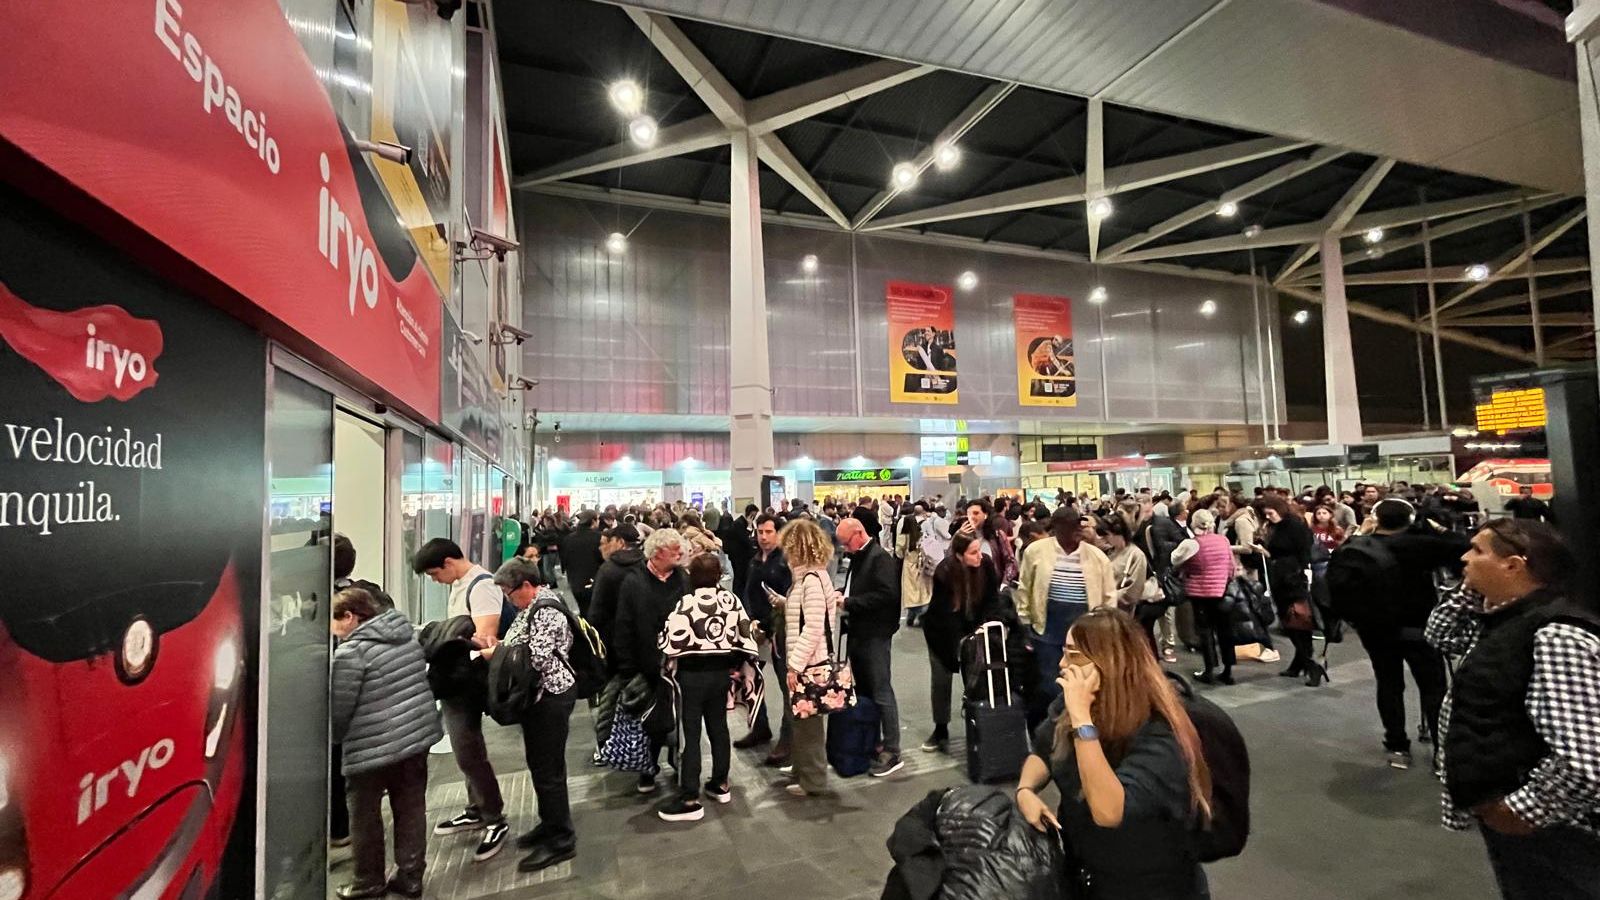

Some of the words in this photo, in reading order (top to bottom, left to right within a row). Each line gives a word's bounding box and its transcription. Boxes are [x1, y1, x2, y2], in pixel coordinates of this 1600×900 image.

[154, 0, 280, 174] Espacio
[319, 152, 379, 316] iryo
[86, 323, 146, 388] iryo
[5, 417, 162, 469] velocidad
[836, 471, 877, 480] natura
[0, 481, 120, 535] nquila.
[77, 738, 175, 825] iryo
